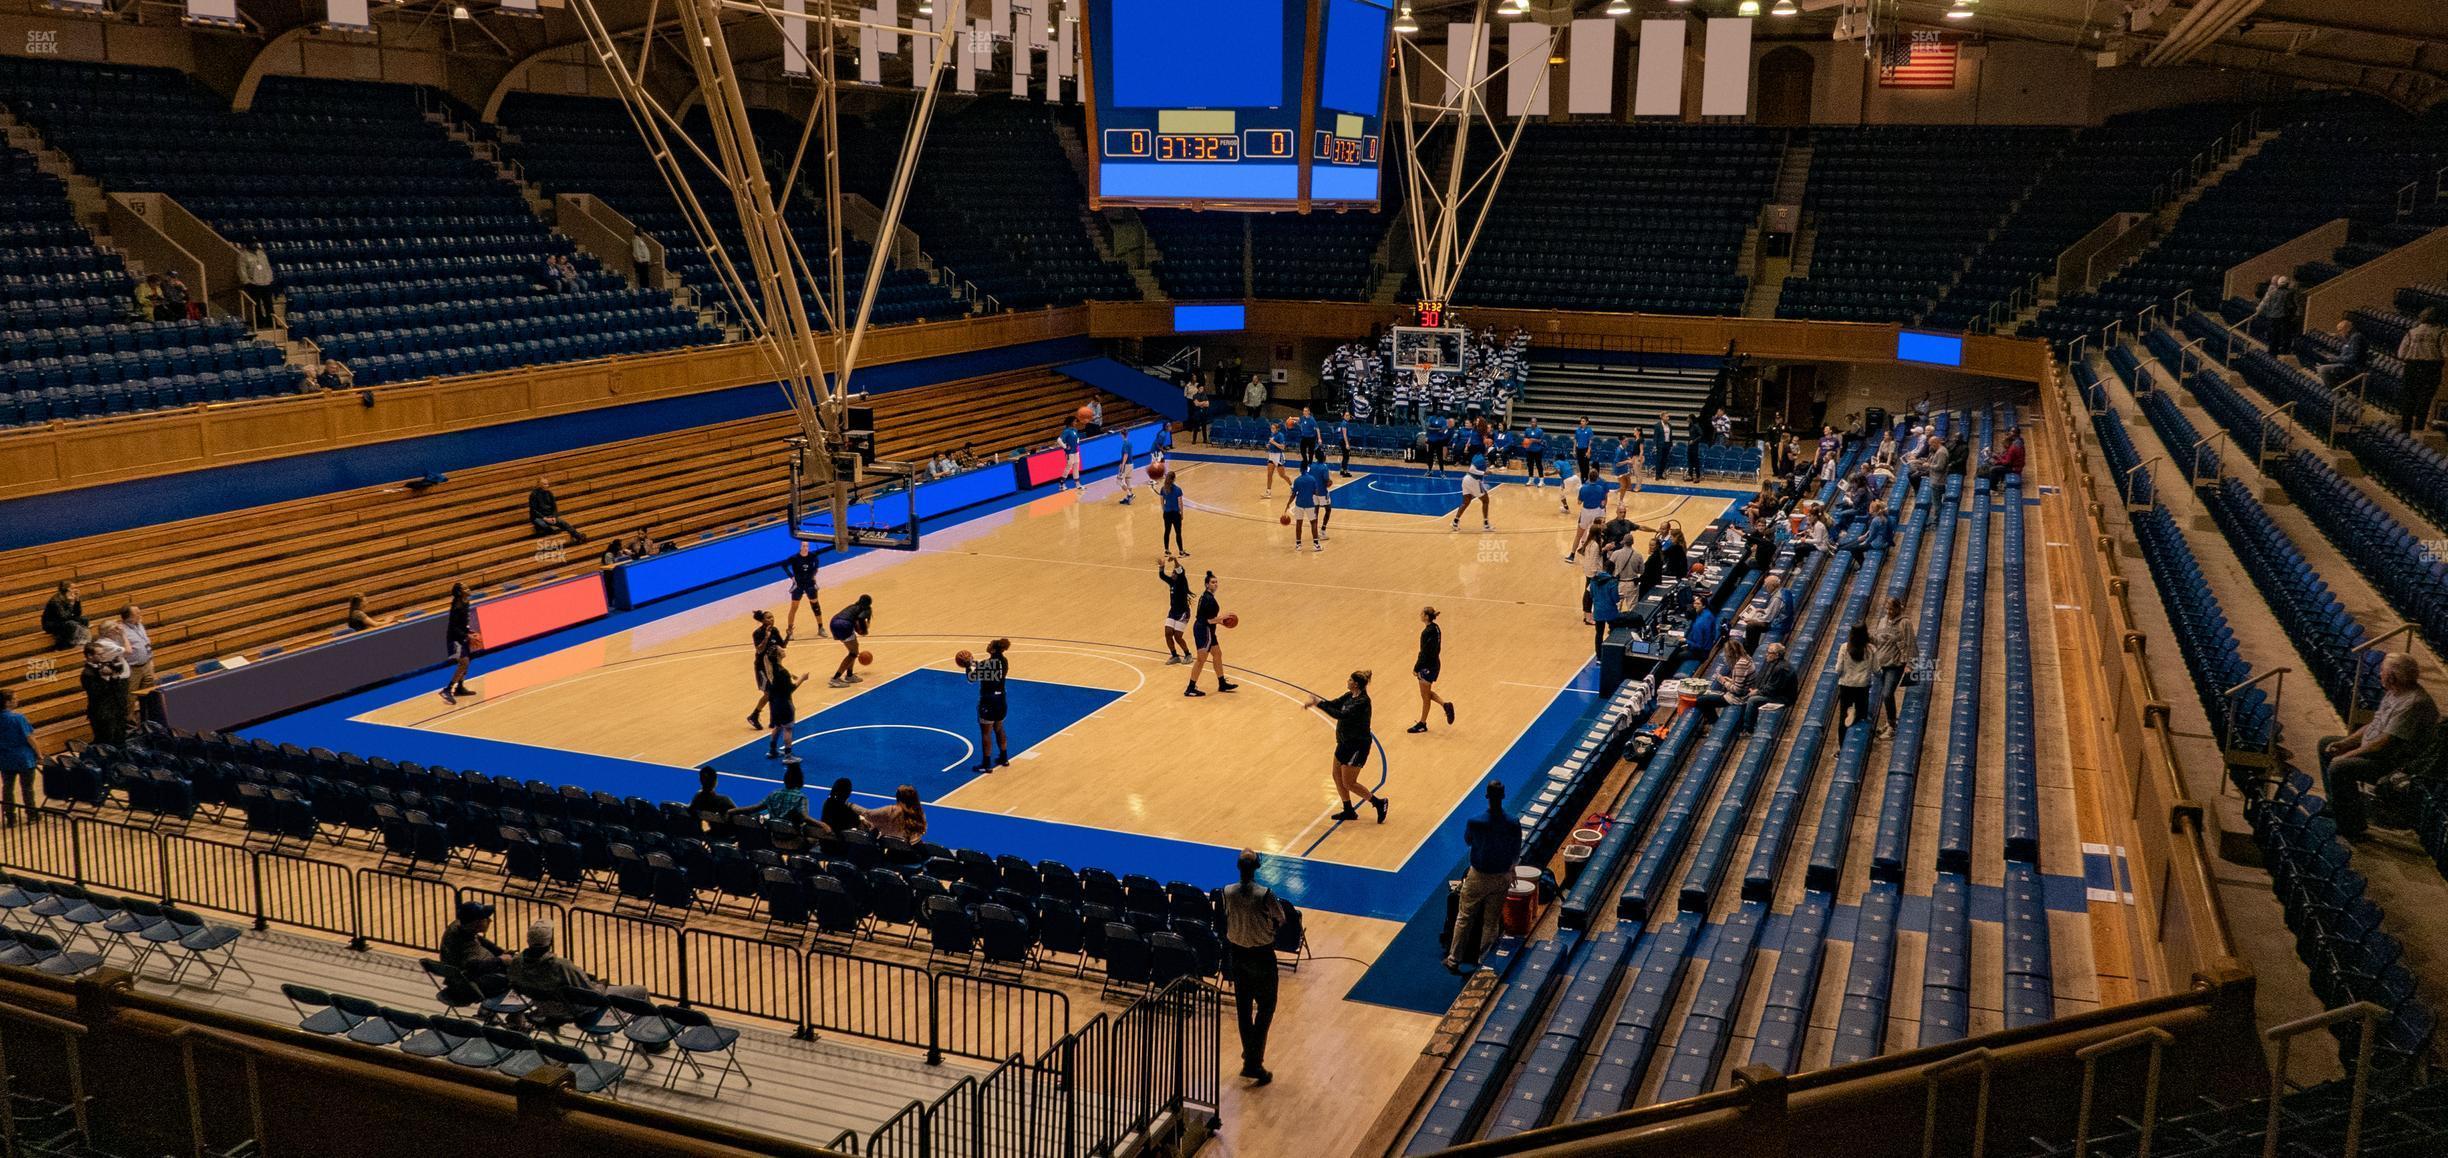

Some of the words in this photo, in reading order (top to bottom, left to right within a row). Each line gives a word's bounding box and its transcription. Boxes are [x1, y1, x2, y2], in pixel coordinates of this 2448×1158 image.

[1131, 132, 1143, 153] 0
[1162, 138, 1219, 159] 37:32
[1272, 132, 1284, 154] 0
[1324, 134, 1330, 156] 0
[1370, 138, 1376, 159] 0
[1418, 302, 1442, 312] 37:32
[1421, 312, 1438, 327] 30
